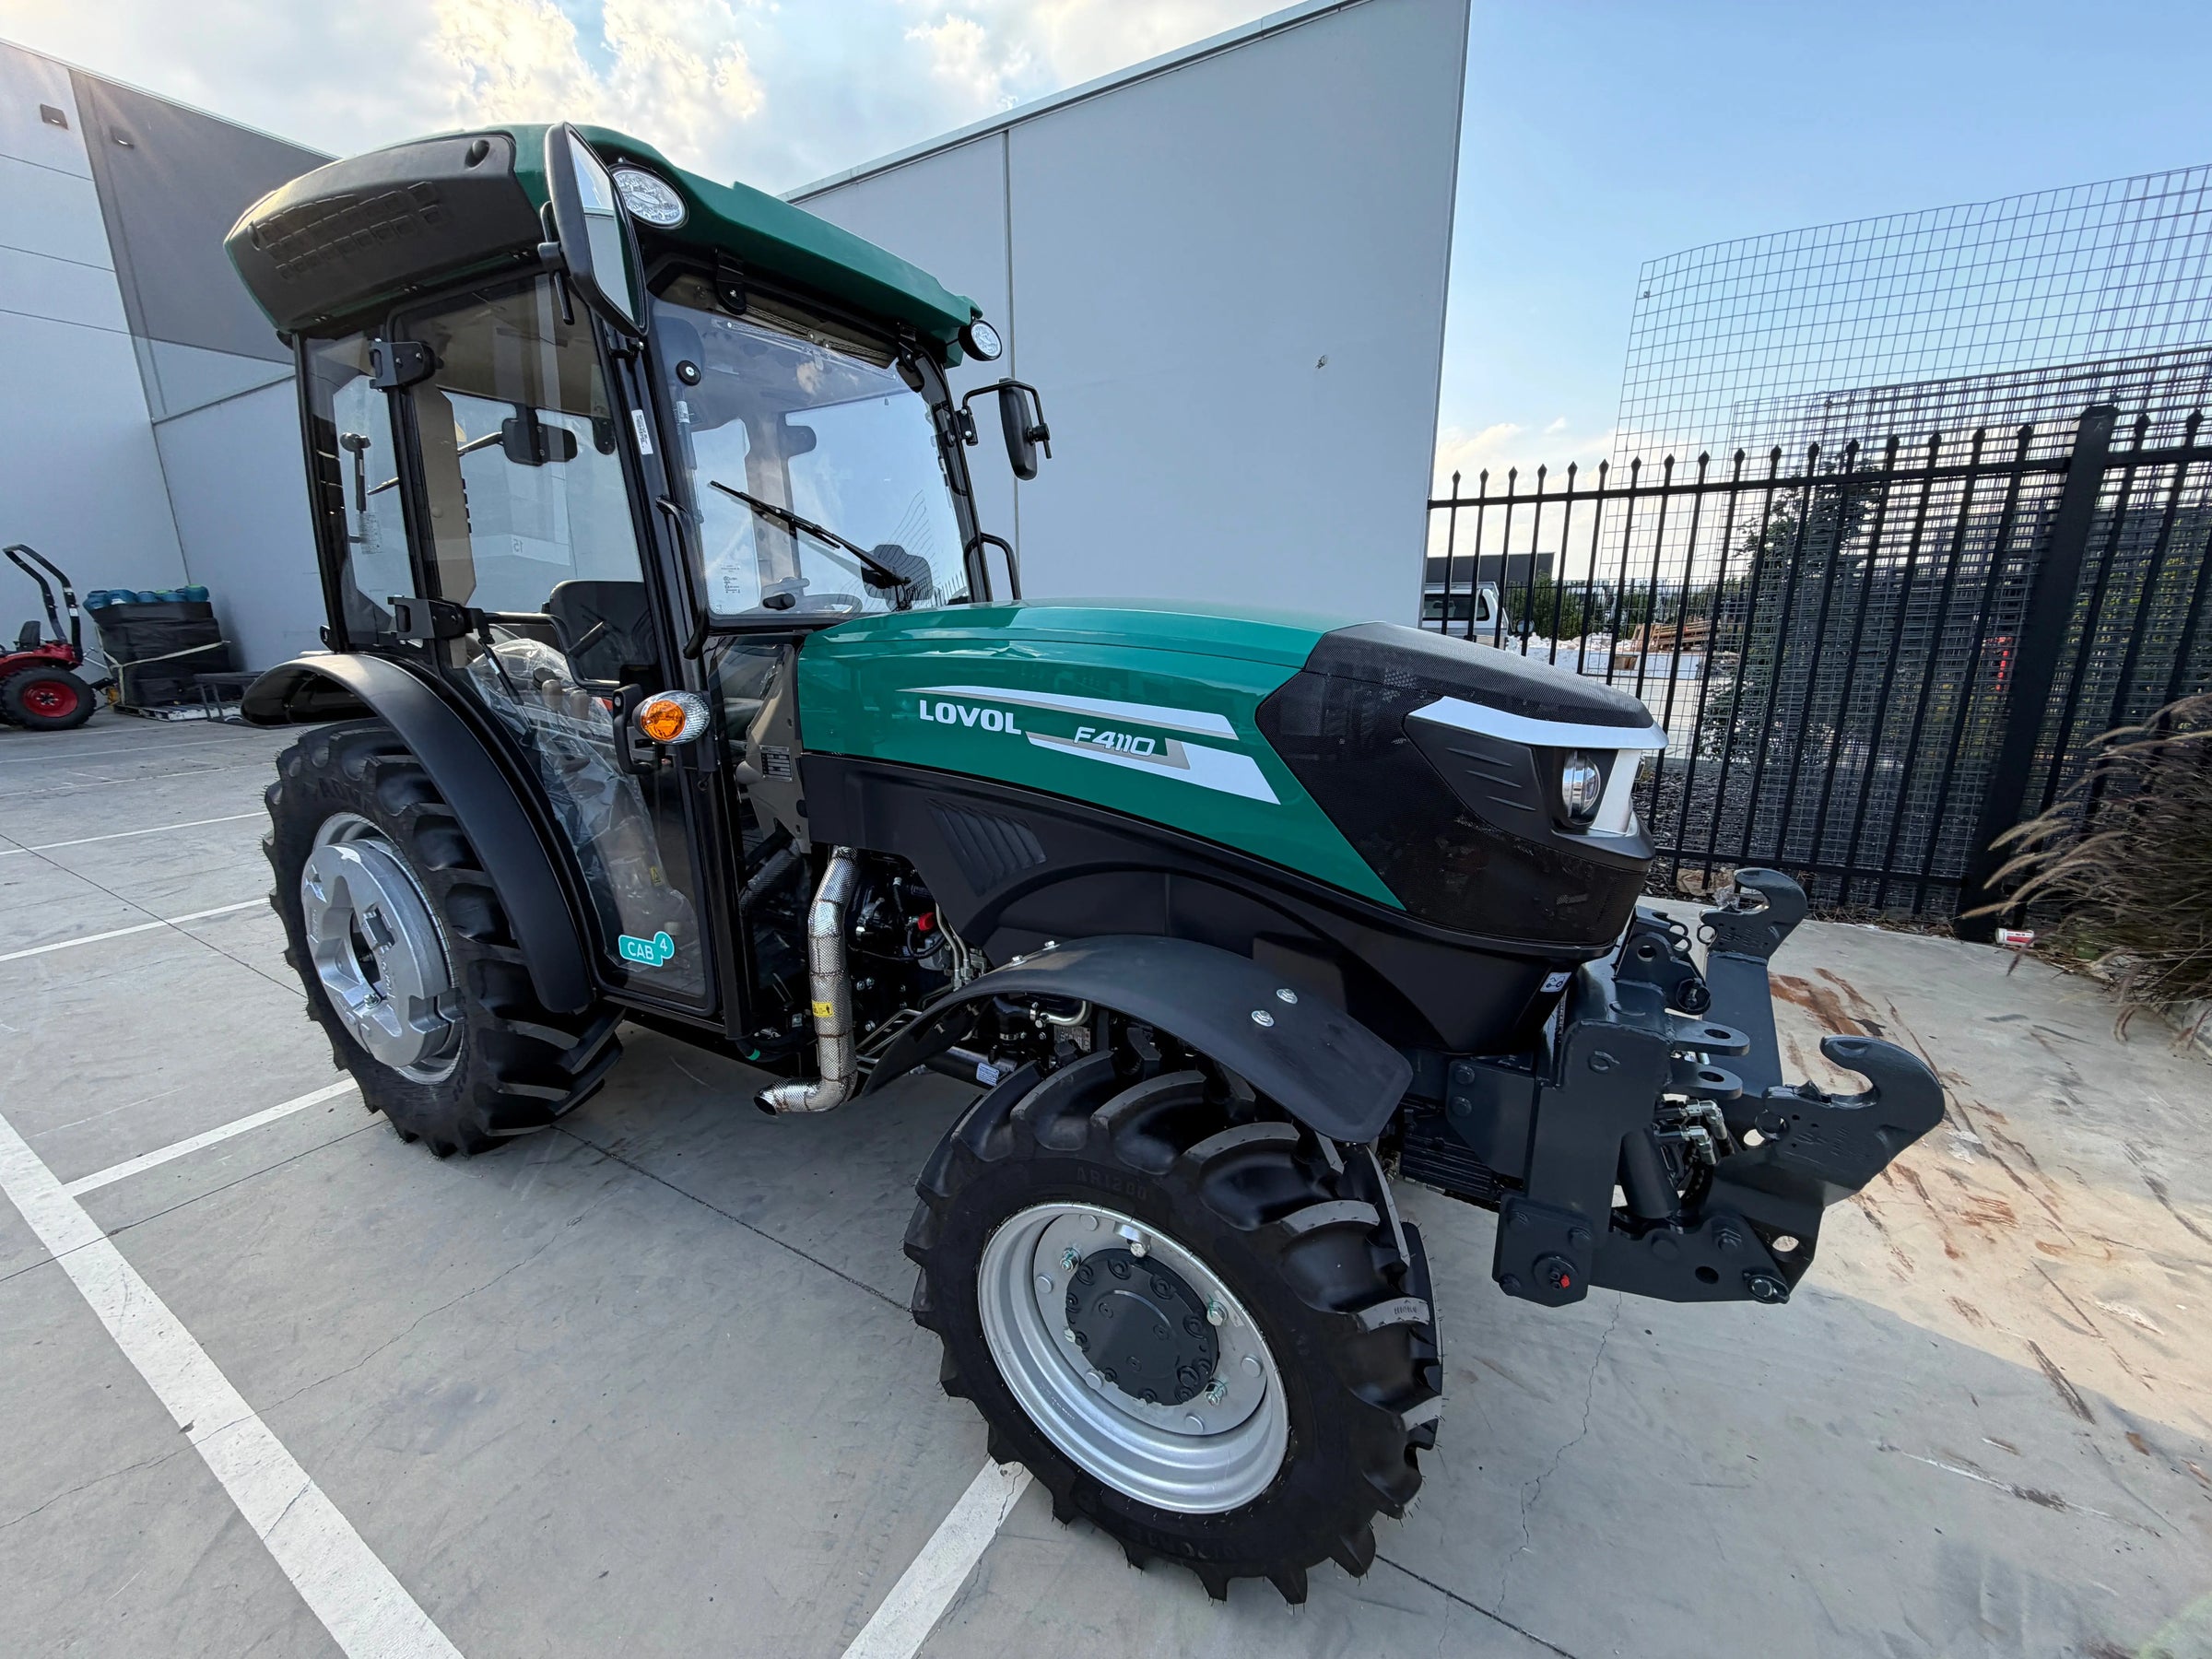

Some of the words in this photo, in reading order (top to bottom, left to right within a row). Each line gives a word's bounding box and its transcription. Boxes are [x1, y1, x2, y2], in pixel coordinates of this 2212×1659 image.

[919, 700, 1022, 735] LOVOL
[1073, 726, 1156, 757] F4110
[627, 941, 654, 960] CAB
[659, 937, 668, 952] 4
